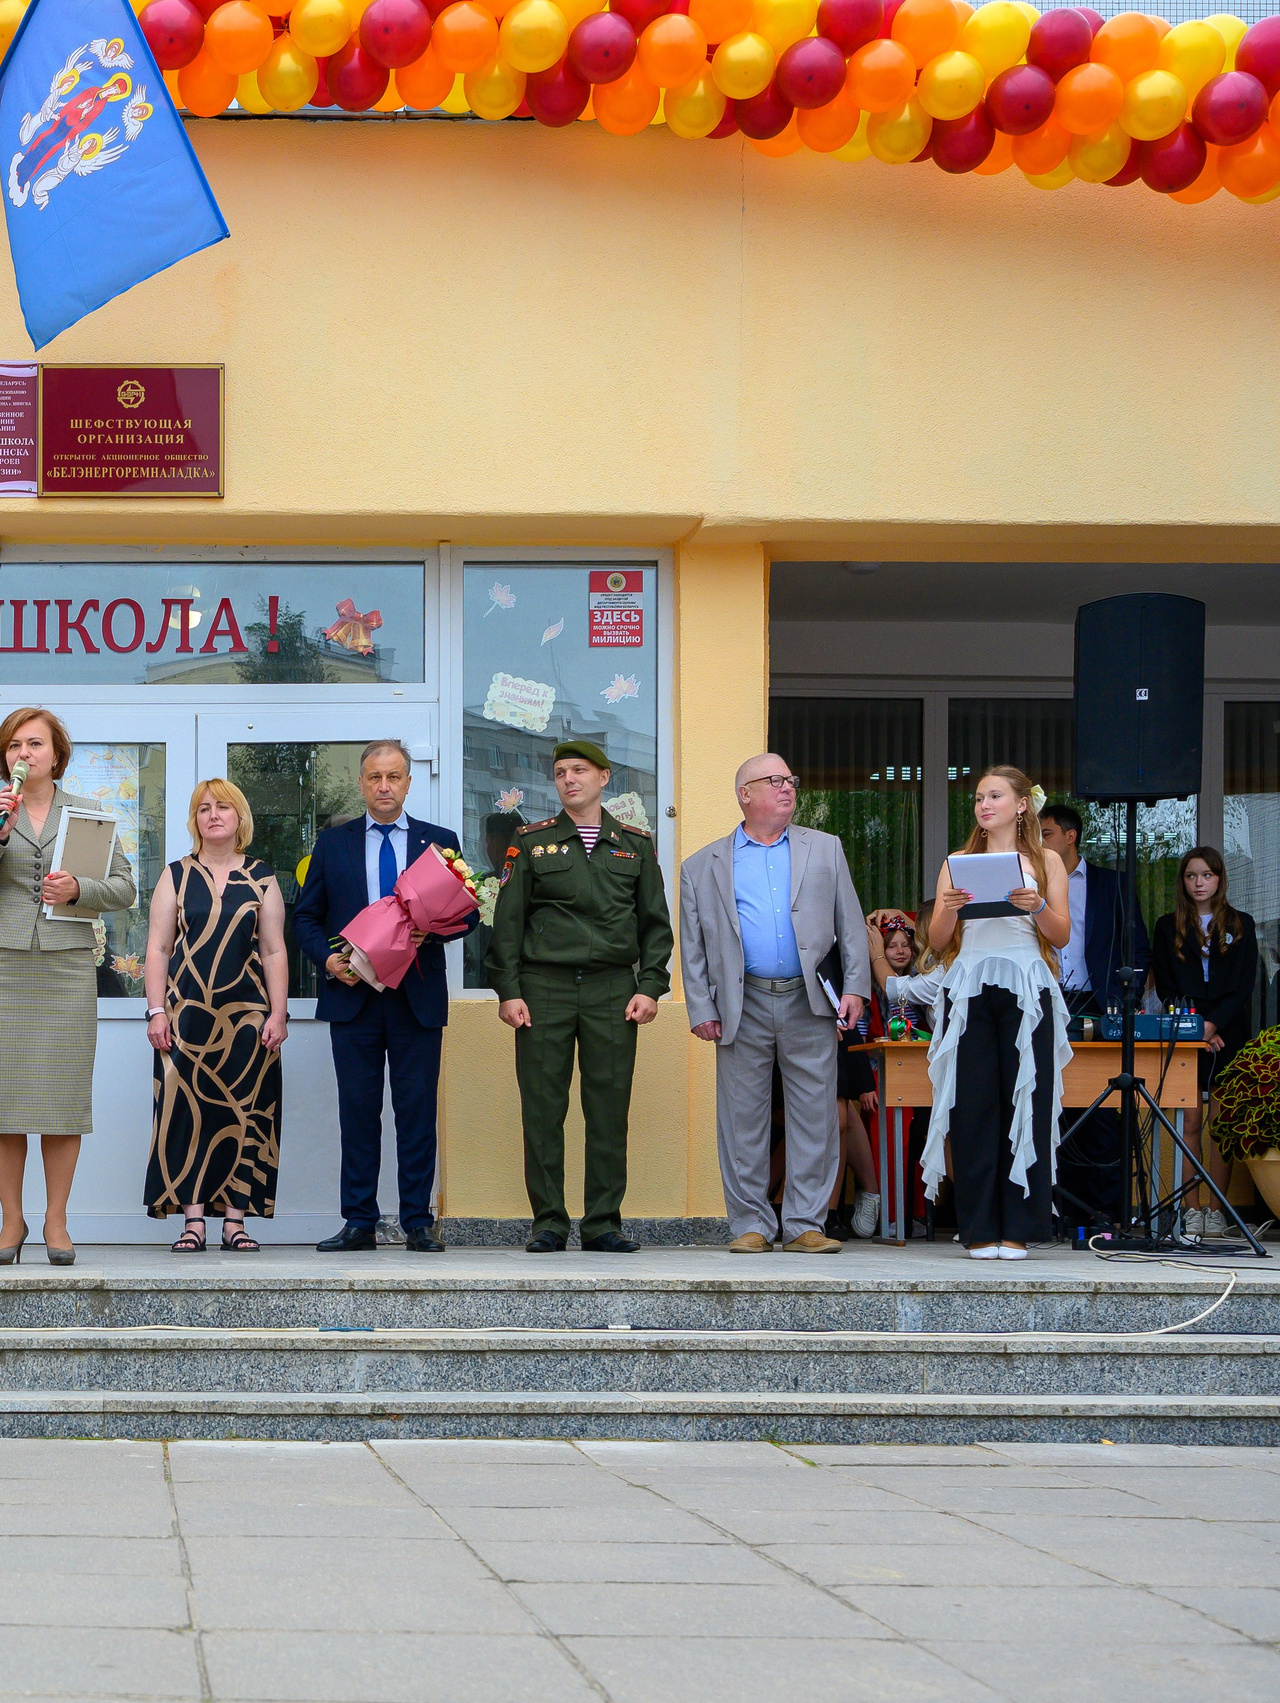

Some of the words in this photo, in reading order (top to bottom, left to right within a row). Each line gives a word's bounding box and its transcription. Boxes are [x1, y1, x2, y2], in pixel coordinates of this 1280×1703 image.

[70, 419, 192, 430] ШЕФСТВУЮЩАЯ
[77, 434, 184, 445] ОРГАНИЗАЦИЯ
[101, 454, 160, 462] АКЦИОНЕРНОЕ
[47, 466, 216, 480] «БЕЛЭНЕРГОРЕМНАЛАДКА»
[593, 611, 640, 625] ЗДЕСЬ
[592, 636, 641, 644] МИЛИЦИЮ
[500, 677, 540, 698] Вперёд
[542, 690, 549, 698] к
[628, 797, 635, 806] в
